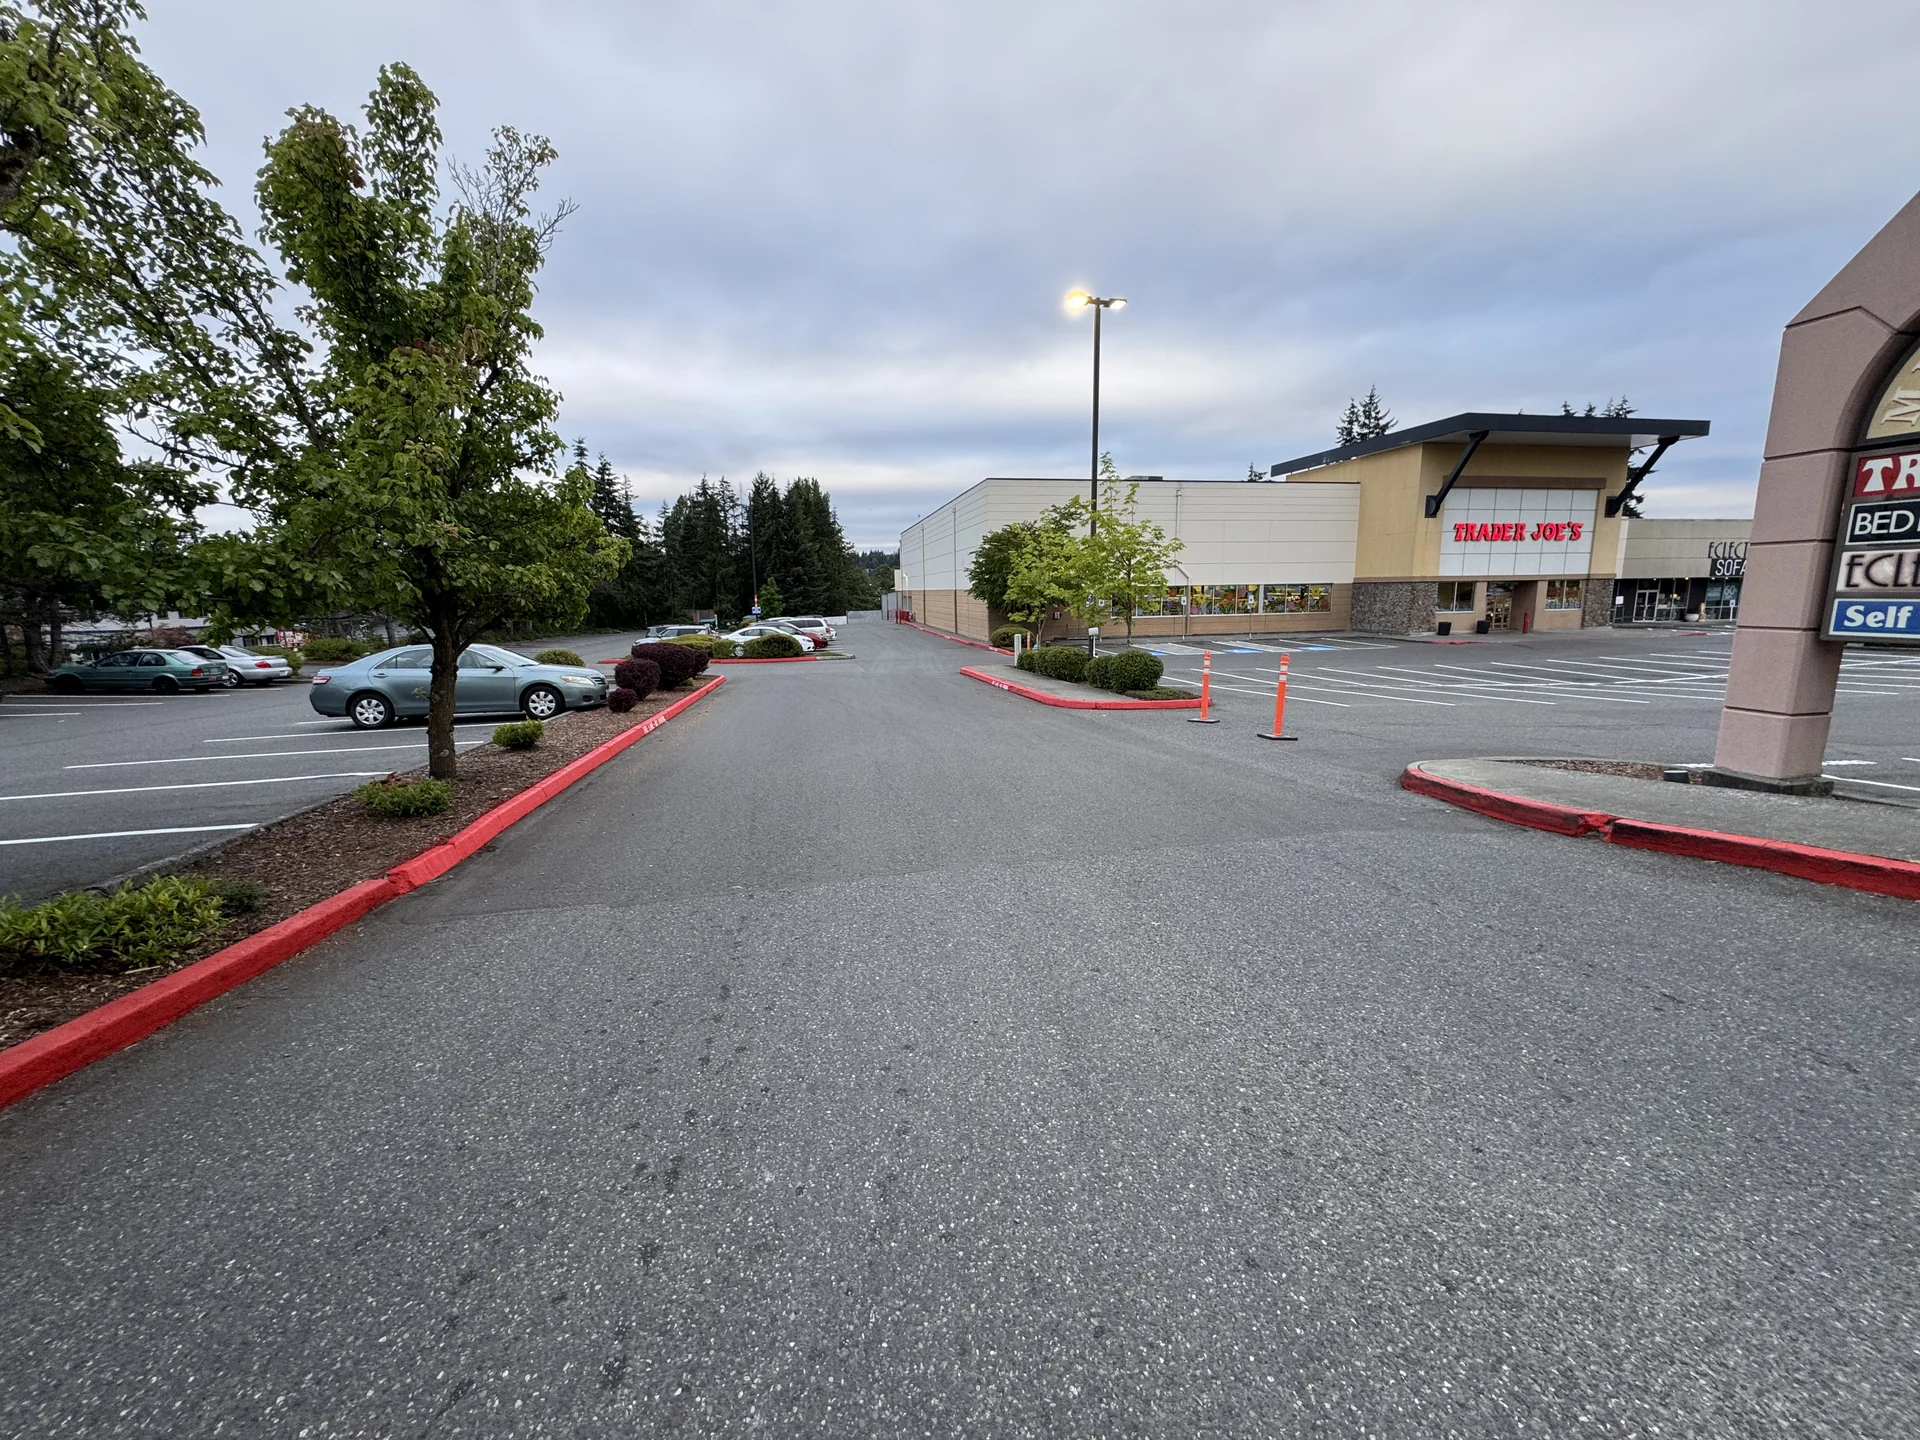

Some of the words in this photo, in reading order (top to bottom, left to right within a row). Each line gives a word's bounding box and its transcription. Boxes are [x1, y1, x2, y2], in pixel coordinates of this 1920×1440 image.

[1453, 523, 1527, 542] TRADER
[1531, 521, 1584, 541] JOE'S
[1854, 509, 1915, 535] BED
[1843, 604, 1914, 629] Self
